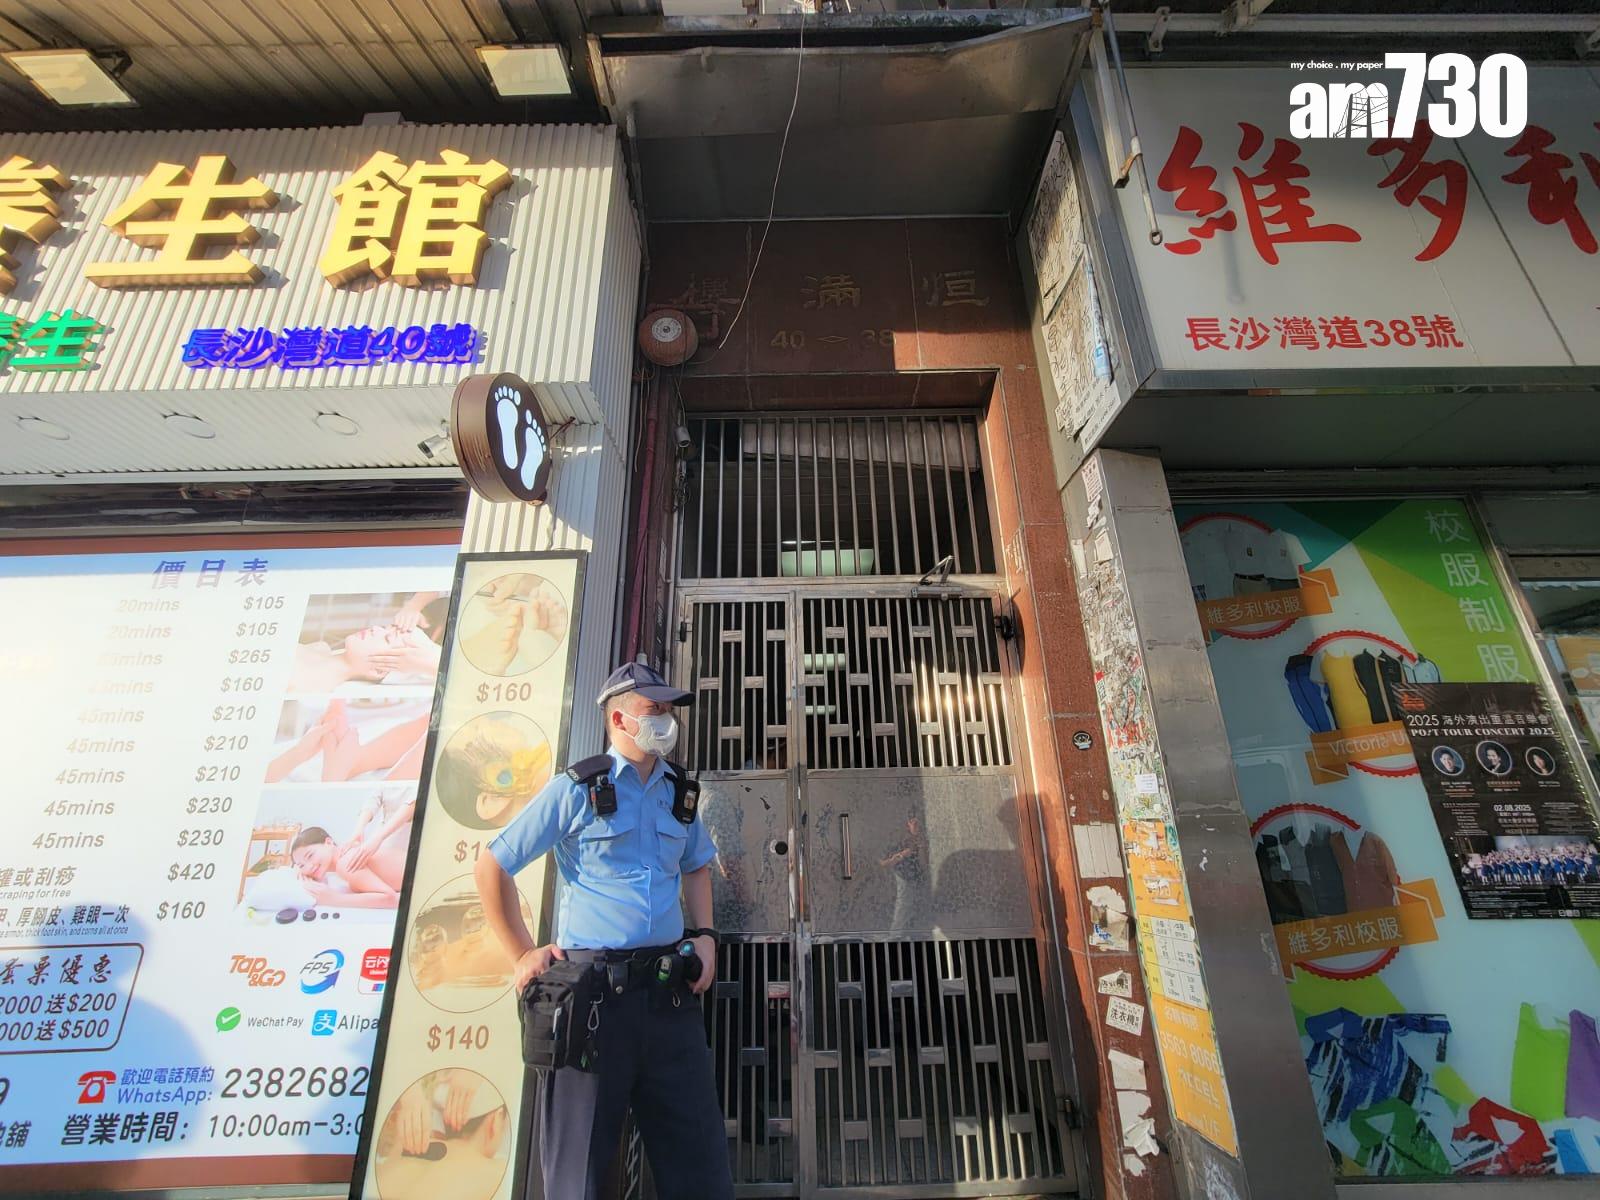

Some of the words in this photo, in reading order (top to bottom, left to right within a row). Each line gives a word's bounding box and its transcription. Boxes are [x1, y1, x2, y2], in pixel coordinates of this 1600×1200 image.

[0, 308, 99, 371] 生
[770, 329, 806, 349] 40
[1185, 314, 1464, 351] 長沙灣道38號
[181, 322, 480, 369] 長沙灣道40號
[151, 558, 268, 589] 價目表
[244, 596, 285, 610] $105
[1424, 510, 1530, 682] 校服制服
[1206, 595, 1304, 626] 維多利校服
[236, 622, 278, 637] $105
[97, 651, 163, 666] mins
[228, 649, 271, 664] $265
[221, 677, 264, 692] $160
[476, 682, 532, 703] $160
[212, 704, 256, 722] $210
[1407, 714, 1440, 727] 2025
[1443, 728, 1473, 737] TOUR
[1475, 727, 1525, 737] CONCERT
[1528, 727, 1555, 736] 2025
[66, 735, 135, 754] 45mins
[203, 734, 248, 752] $210
[55, 766, 125, 785] 45mins
[195, 765, 240, 783] $210
[43, 798, 114, 816] 45mins
[186, 797, 232, 814] $230
[32, 831, 104, 850] 45mins
[177, 829, 224, 847] $230
[454, 840, 490, 862] $1
[167, 862, 215, 881] $420
[157, 901, 205, 920] $160
[1288, 917, 1402, 955] 維多利校服
[230, 955, 267, 977] Tap
[300, 961, 334, 974] FPS
[247, 1017, 284, 1028] WeChat
[286, 1016, 304, 1029] Pay
[427, 1025, 489, 1051] $140
[121, 1066, 214, 1086] 歡迎電話預約
[221, 1067, 369, 1098] 2382682
[117, 1086, 213, 1106] WhatsApp:
